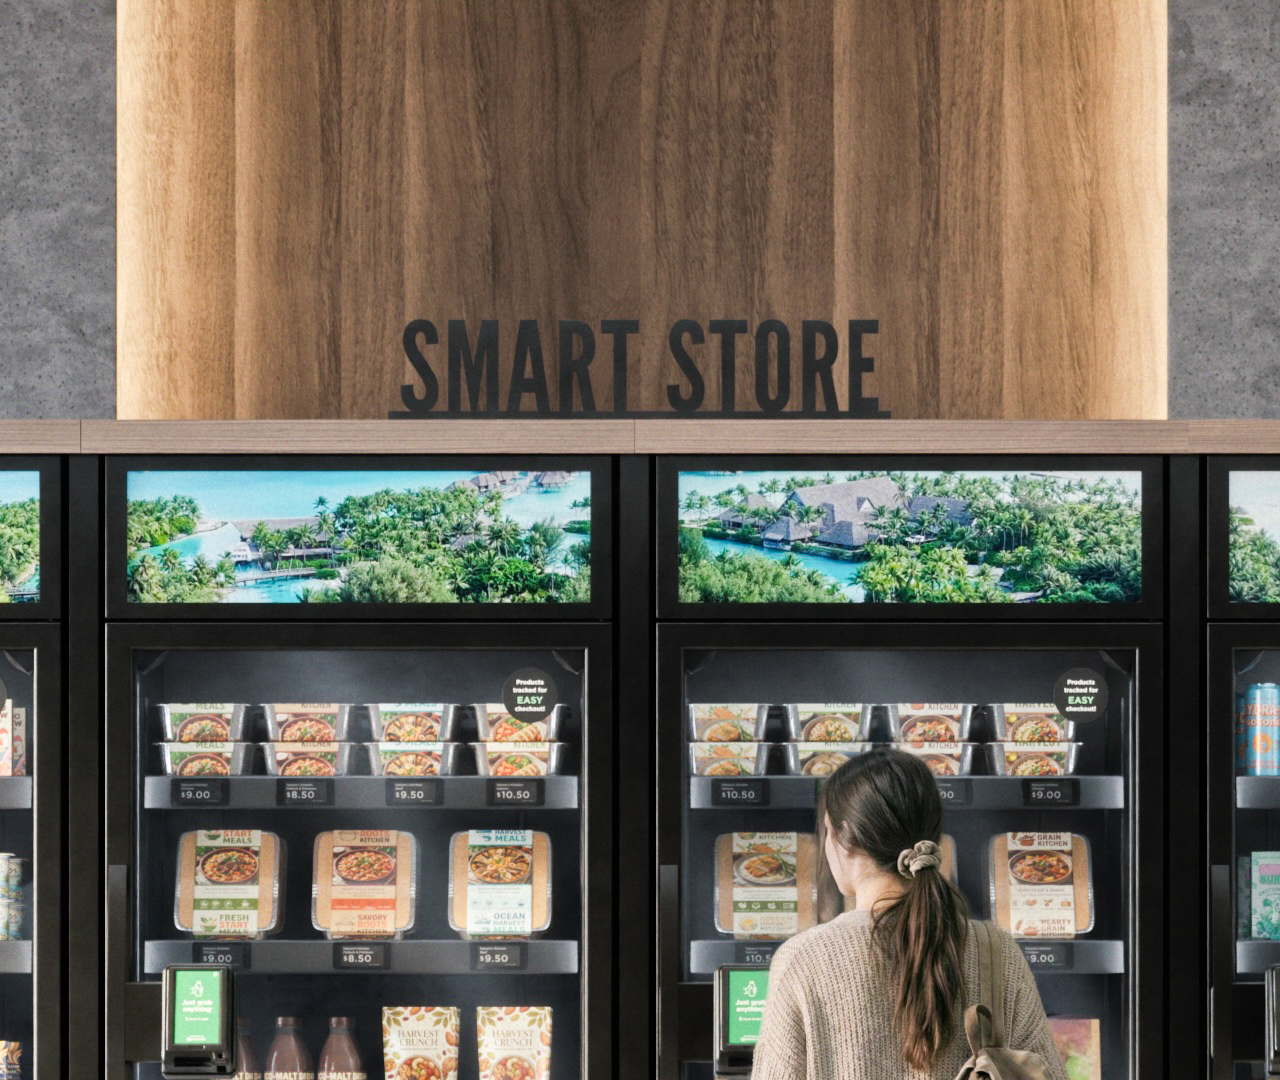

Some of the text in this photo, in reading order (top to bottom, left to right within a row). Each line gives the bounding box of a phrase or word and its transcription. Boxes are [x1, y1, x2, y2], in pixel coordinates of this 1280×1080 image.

[400, 319, 880, 412] SMART STORE
[517, 696, 543, 704] EASY
[1068, 696, 1094, 704] EASY
[181, 791, 210, 799] $9.00
[286, 791, 315, 799] $8.50
[395, 791, 424, 799] $9.50
[496, 791, 530, 799] $10.50
[722, 791, 755, 799] $10.50
[1032, 791, 1061, 799] $9.00
[203, 955, 232, 963] $9.00
[343, 955, 371, 963] $8.50
[480, 955, 508, 963] $9.50
[397, 1030, 440, 1038] HARVEST
[492, 1030, 534, 1038] HARVEST
[399, 1038, 438, 1047] CRUNCH
[494, 1038, 533, 1047] CRUNCH
